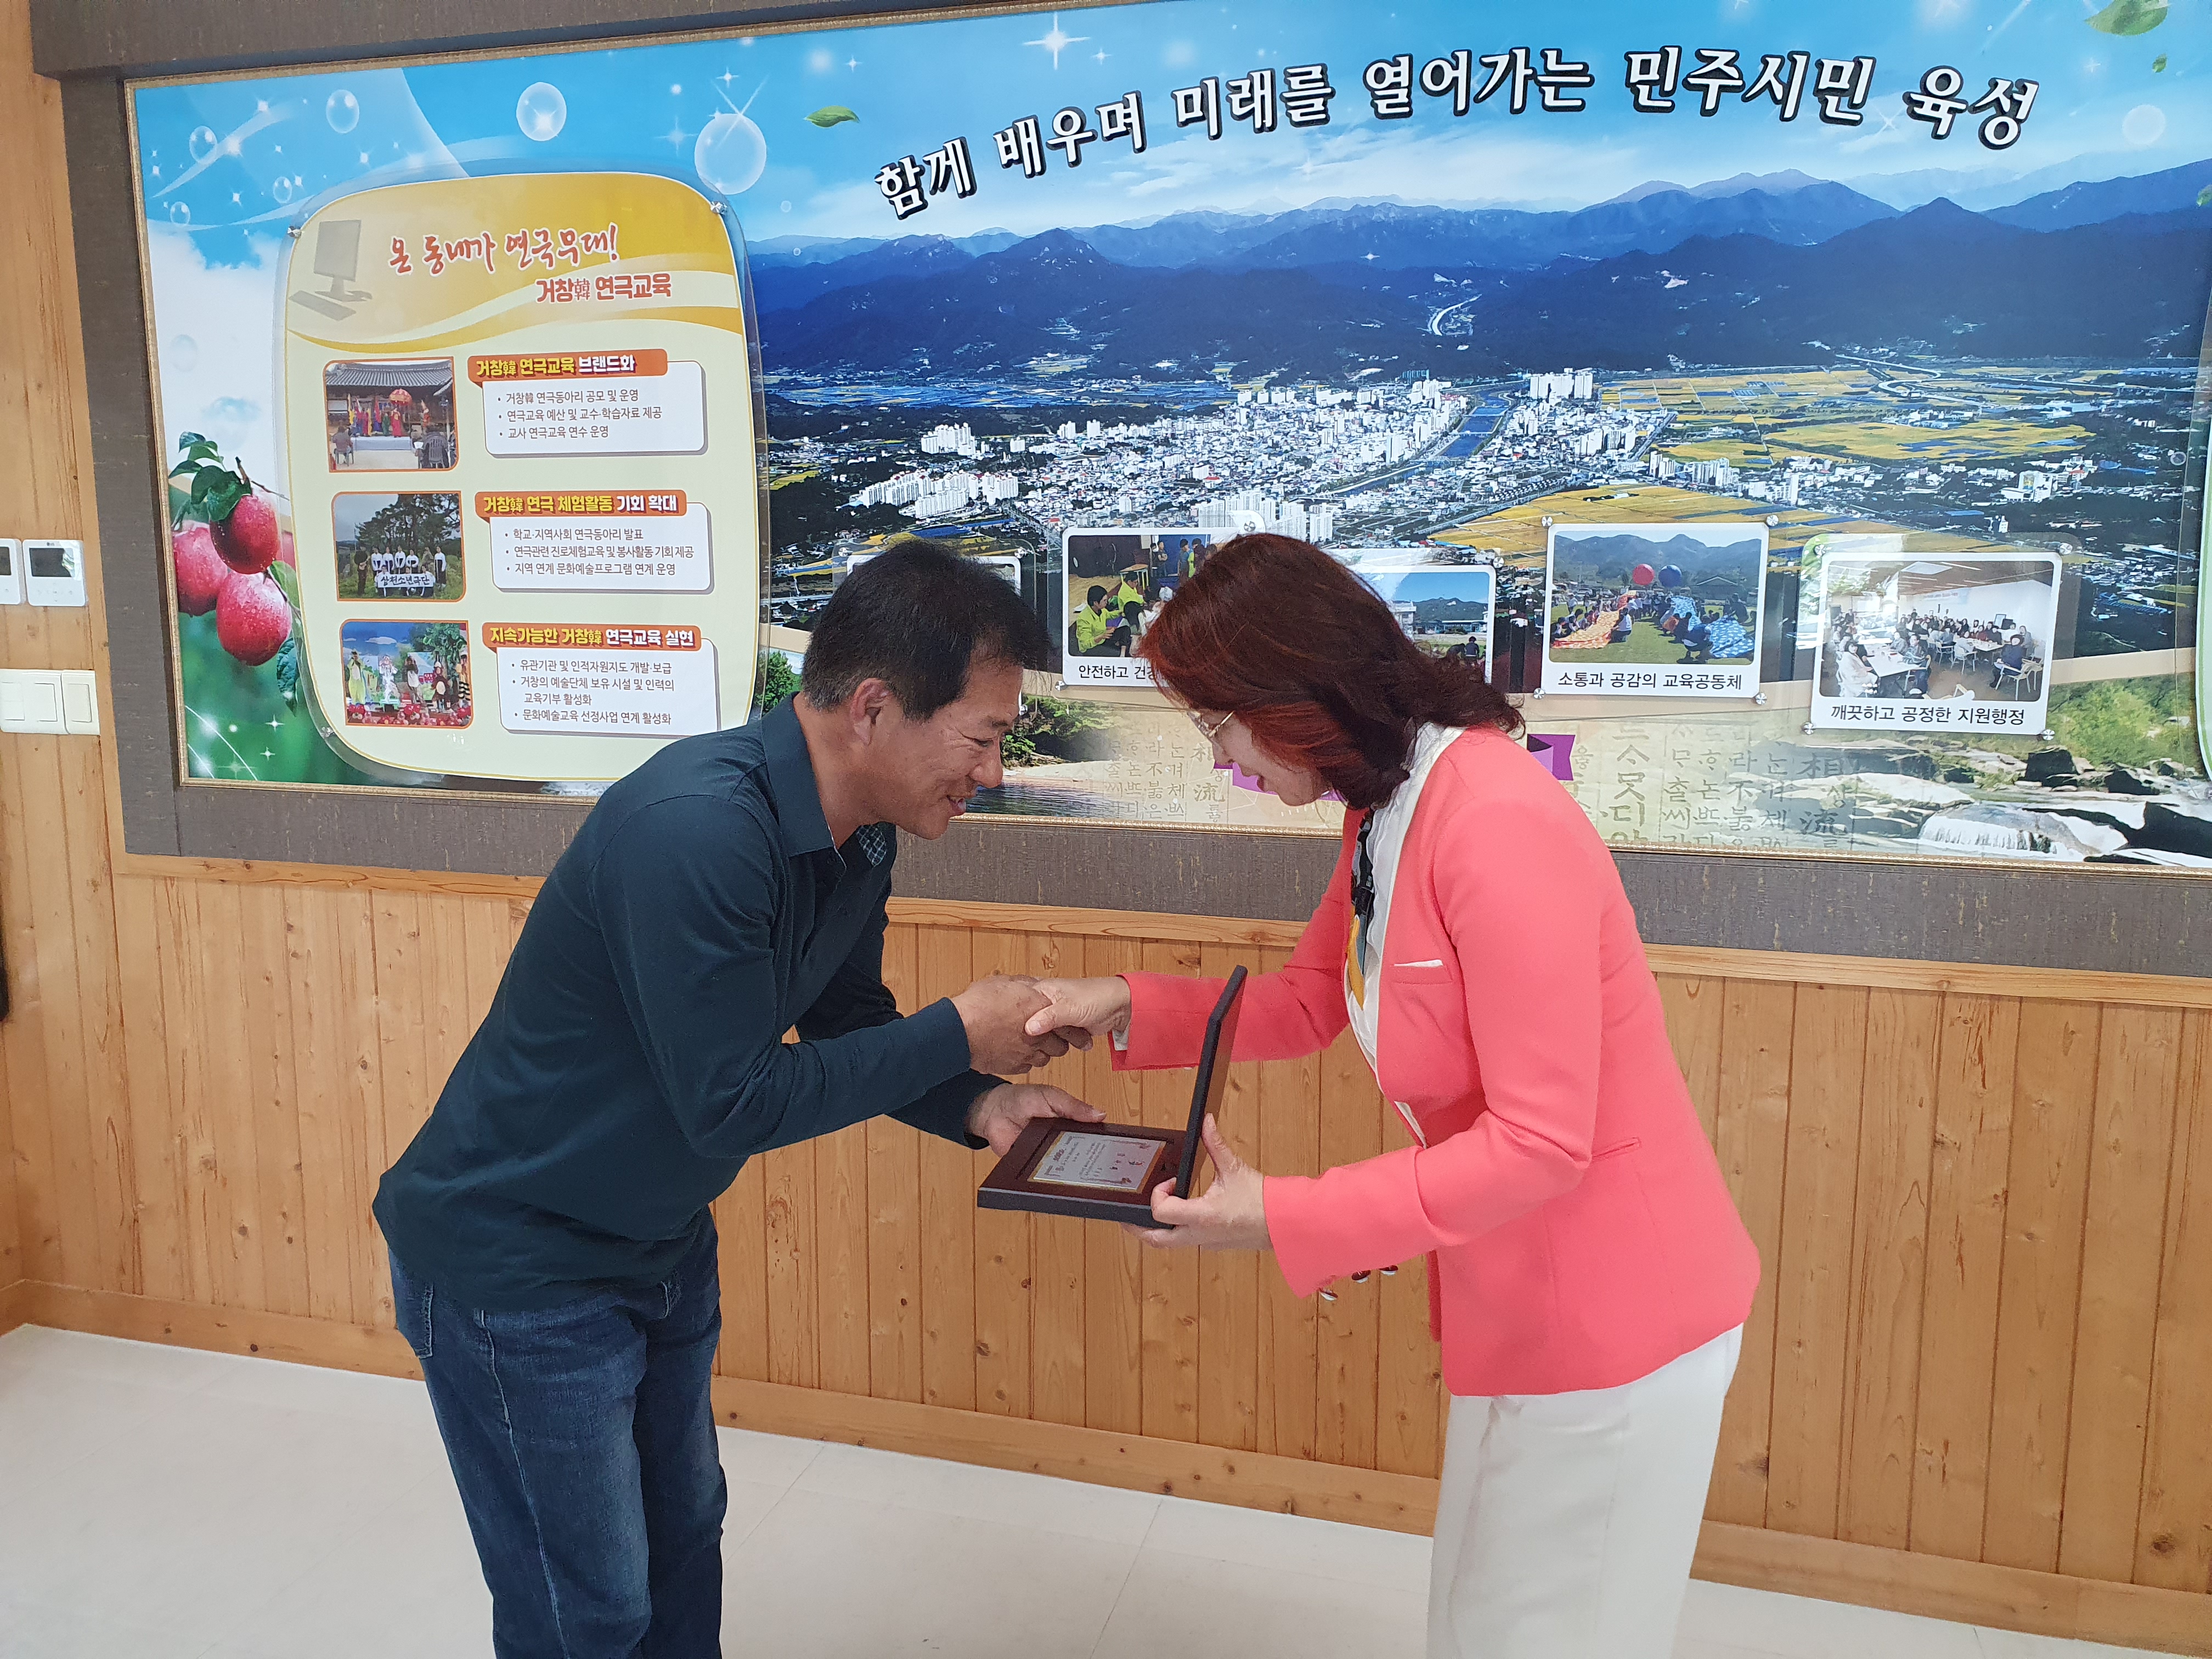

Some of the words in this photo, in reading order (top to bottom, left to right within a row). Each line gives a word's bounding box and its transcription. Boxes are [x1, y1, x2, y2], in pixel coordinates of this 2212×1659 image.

[874, 136, 977, 219] 함께
[994, 91, 1144, 178] 배우며
[1171, 64, 1336, 140] 미래를
[1362, 48, 1593, 118] 열어가는
[1624, 47, 1875, 126] 민주시민
[1903, 65, 2039, 150] 육성
[389, 236, 411, 273] 온
[424, 233, 494, 274] 동네가
[505, 223, 618, 269] 연극무대!
[537, 278, 590, 302] 거창韓
[596, 273, 672, 300] 연극교육
[476, 360, 517, 377] 거창韓
[520, 358, 575, 376] 연극교육
[578, 355, 636, 374] 브랜드화
[506, 392, 534, 405] 거창韓
[537, 391, 583, 404] 연극동아리
[586, 391, 605, 402] 공모
[607, 390, 617, 402] 및
[619, 389, 639, 402] 운영
[507, 410, 544, 422] 연극교육
[546, 409, 565, 421] 예산
[568, 408, 577, 420] 및
[642, 407, 662, 419] 제공
[509, 427, 526, 439] 교사
[529, 426, 566, 439] 연극교육
[568, 426, 588, 438] 연수
[590, 425, 608, 438] 운영
[483, 496, 523, 514] 거창韓
[527, 496, 555, 513] 연극
[557, 495, 613, 512] 체험활동
[617, 495, 645, 512] 기회
[648, 495, 678, 512] 확대
[574, 528, 621, 540] 연극동아리
[624, 528, 644, 540] 발표
[514, 545, 549, 557] 연극관련
[551, 545, 605, 558] 진로체험교육
[606, 545, 616, 558] 및
[617, 546, 653, 558] 봉사활동
[655, 546, 674, 558] 기회
[675, 546, 694, 558] 제공
[515, 562, 533, 574] 지역
[536, 562, 554, 574] 연계
[556, 563, 632, 575] 문화예술프로그램
[635, 563, 653, 575] 연계
[656, 563, 675, 575] 운영
[381, 575, 430, 586] 상천소년극단
[490, 627, 558, 645] 지속가능한
[562, 628, 602, 646] 거창韓
[605, 629, 661, 646] 연극교육
[665, 630, 694, 647] 실현
[520, 660, 557, 672] 유관기관
[560, 661, 569, 672] 및
[571, 661, 628, 673] 인적자원지도
[1079, 665, 1129, 679] 안전하고
[521, 676, 548, 688] 거창의
[551, 677, 588, 689] 예술단체
[590, 678, 610, 690] 보유
[612, 679, 631, 690] 시설
[634, 679, 642, 690] 및
[645, 679, 674, 691] 인력의
[1558, 672, 1604, 687] 소통과
[1611, 673, 1656, 689] 공감의
[1663, 674, 1742, 690] 교육공동체
[524, 693, 561, 704] 교육기부
[563, 693, 592, 706] 활성화
[523, 709, 579, 721] 문화예술교육
[581, 711, 618, 723] 선정사업
[620, 712, 640, 724] 연계
[642, 713, 672, 725] 활성화
[1831, 705, 1895, 722] 깨끗하고
[1901, 707, 1951, 723] 공정한
[1958, 708, 2025, 725] 지원행정
